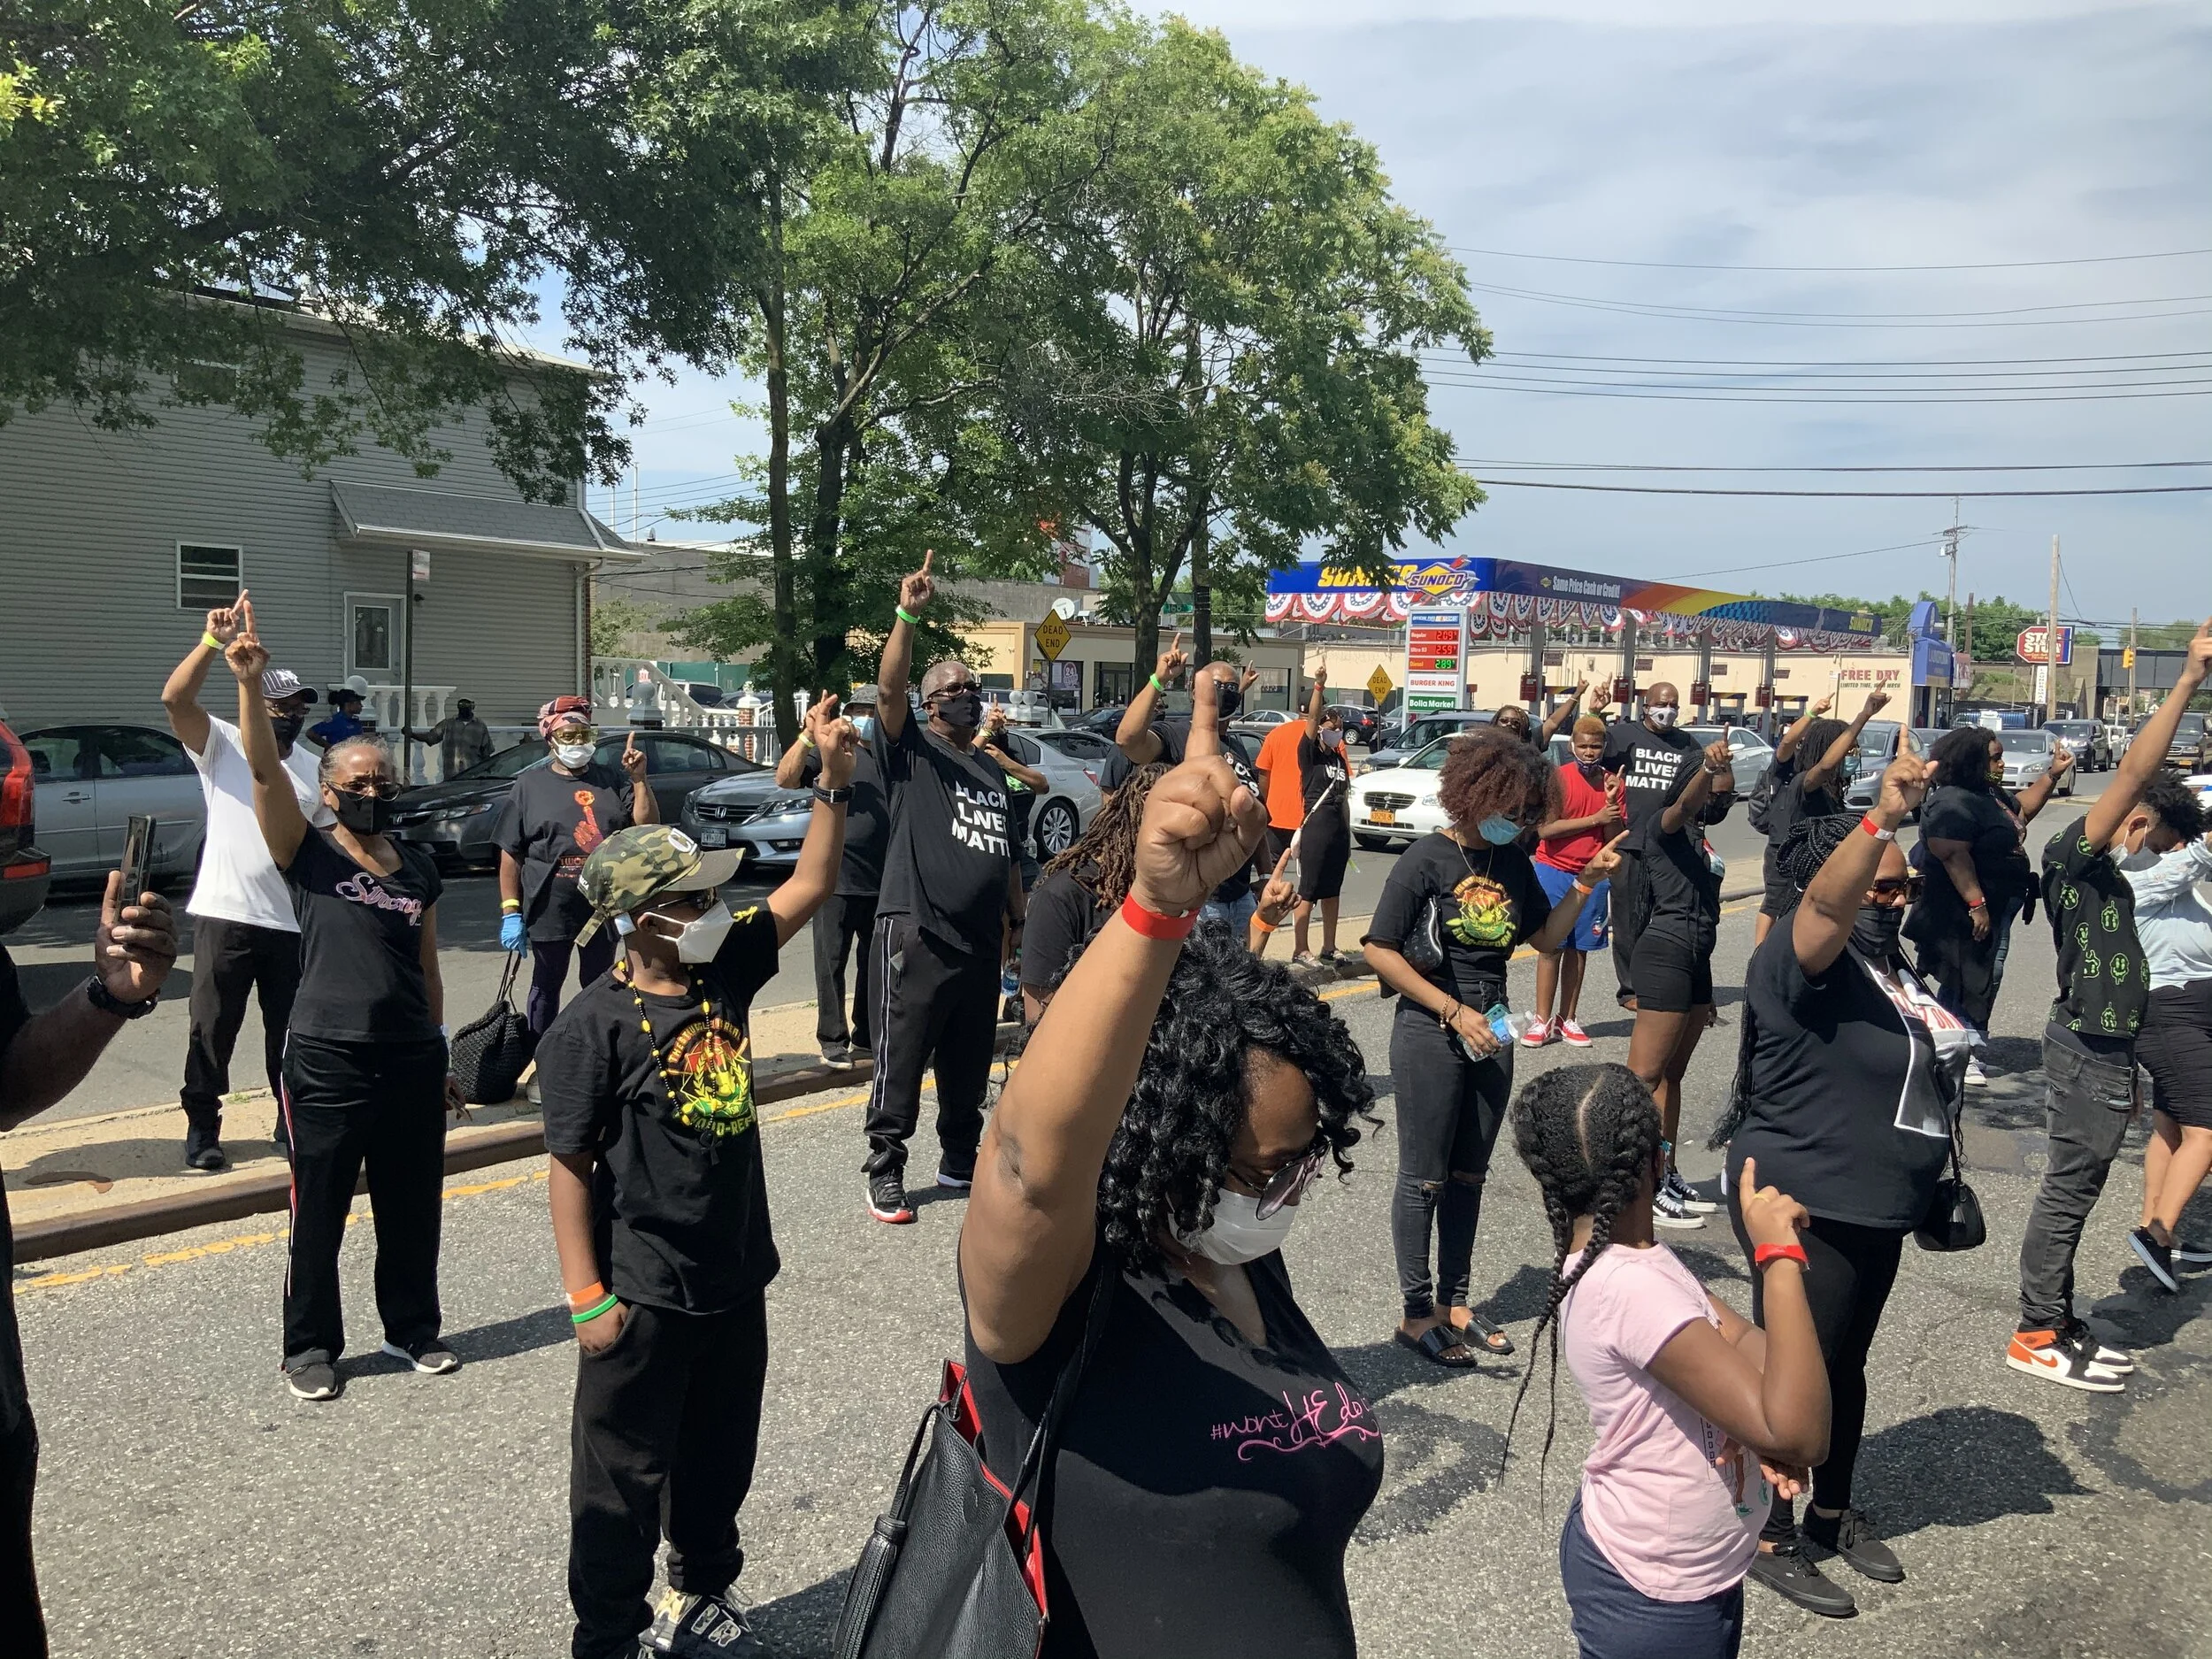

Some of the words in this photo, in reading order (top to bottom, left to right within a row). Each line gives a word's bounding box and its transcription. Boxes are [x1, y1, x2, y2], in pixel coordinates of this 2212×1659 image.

[1317, 565, 1417, 588] SUNO
[1409, 572, 1466, 588] SUNOCO
[1552, 575, 1569, 592] Same
[1568, 578, 1584, 595] Price
[1583, 580, 1596, 595] Cash
[1596, 584, 1603, 596] or
[1042, 625, 1064, 635] DEAD
[1045, 638, 1060, 648] END
[1840, 670, 1871, 680] FREE
[1876, 670, 1901, 680] DRY
[1635, 748, 1683, 764] BLACK
[1624, 774, 1673, 791] MATT
[951, 818, 1010, 857] MATT
